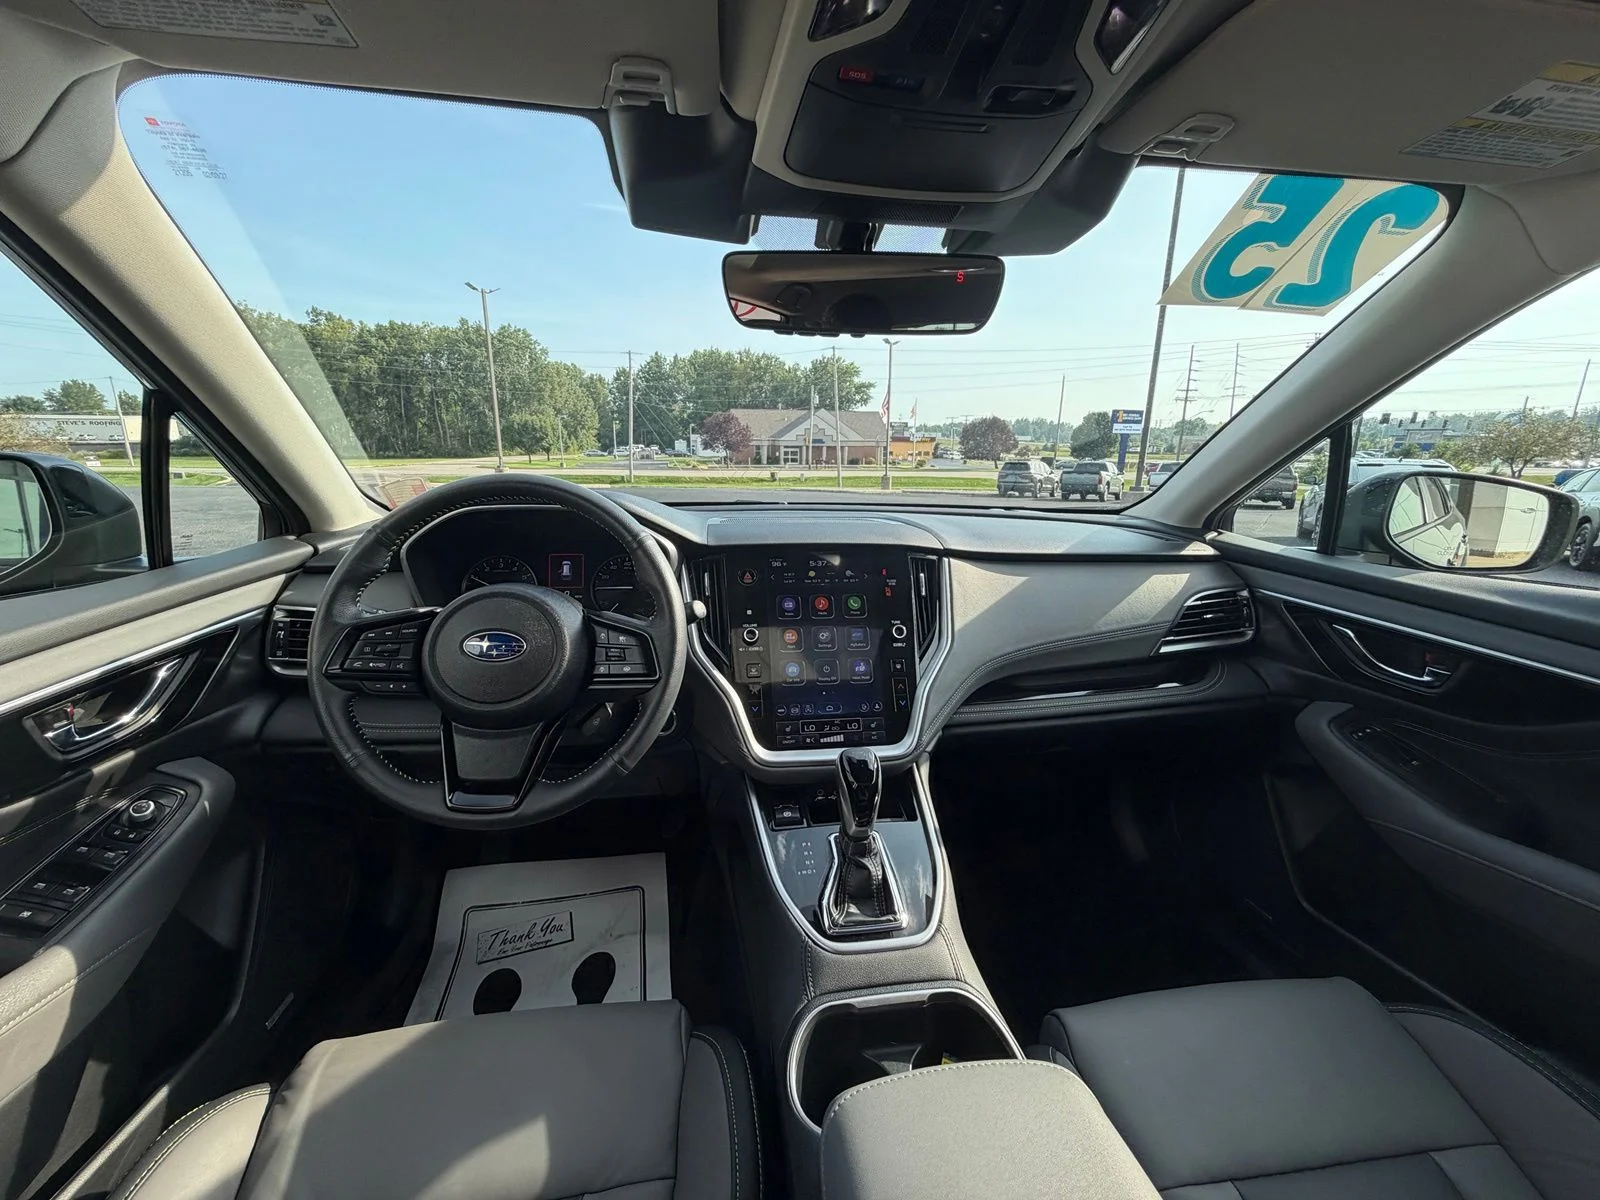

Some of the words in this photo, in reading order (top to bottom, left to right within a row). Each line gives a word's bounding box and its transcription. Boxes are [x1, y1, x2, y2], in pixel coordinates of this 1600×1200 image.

[848, 71, 866, 79] SOS
[956, 271, 965, 282] S
[804, 724, 816, 732] LO
[847, 722, 858, 730] LO
[488, 922, 537, 951] Thank
[540, 916, 564, 937] You
